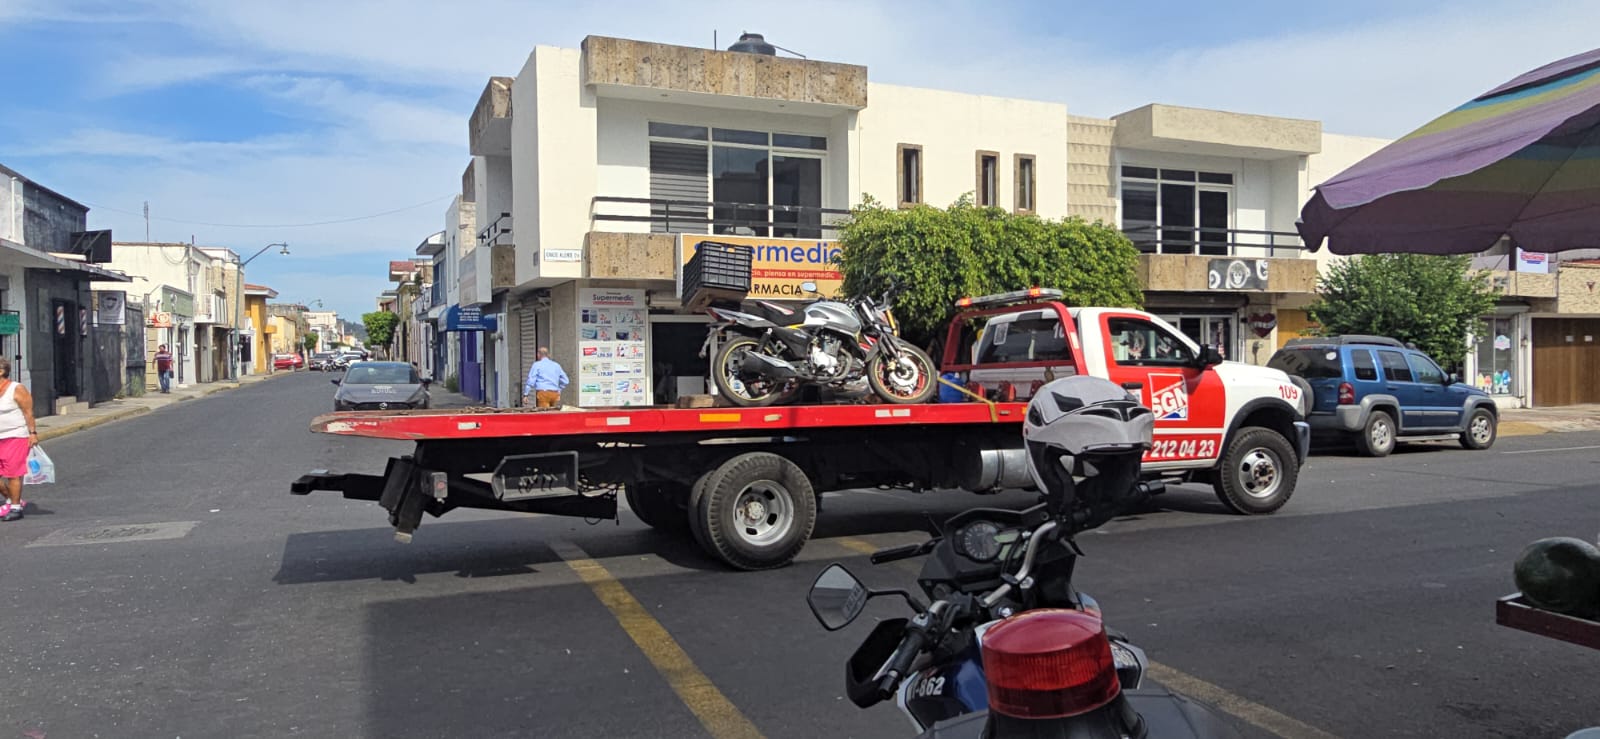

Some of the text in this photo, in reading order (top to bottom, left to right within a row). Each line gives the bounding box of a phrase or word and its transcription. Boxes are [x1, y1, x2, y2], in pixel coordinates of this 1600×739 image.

[749, 283, 803, 295] RMACIA
[592, 293, 634, 302] Supermedic
[1279, 384, 1298, 399] 109
[1152, 387, 1187, 418] SGN
[1150, 440, 1215, 458] 212 04 23
